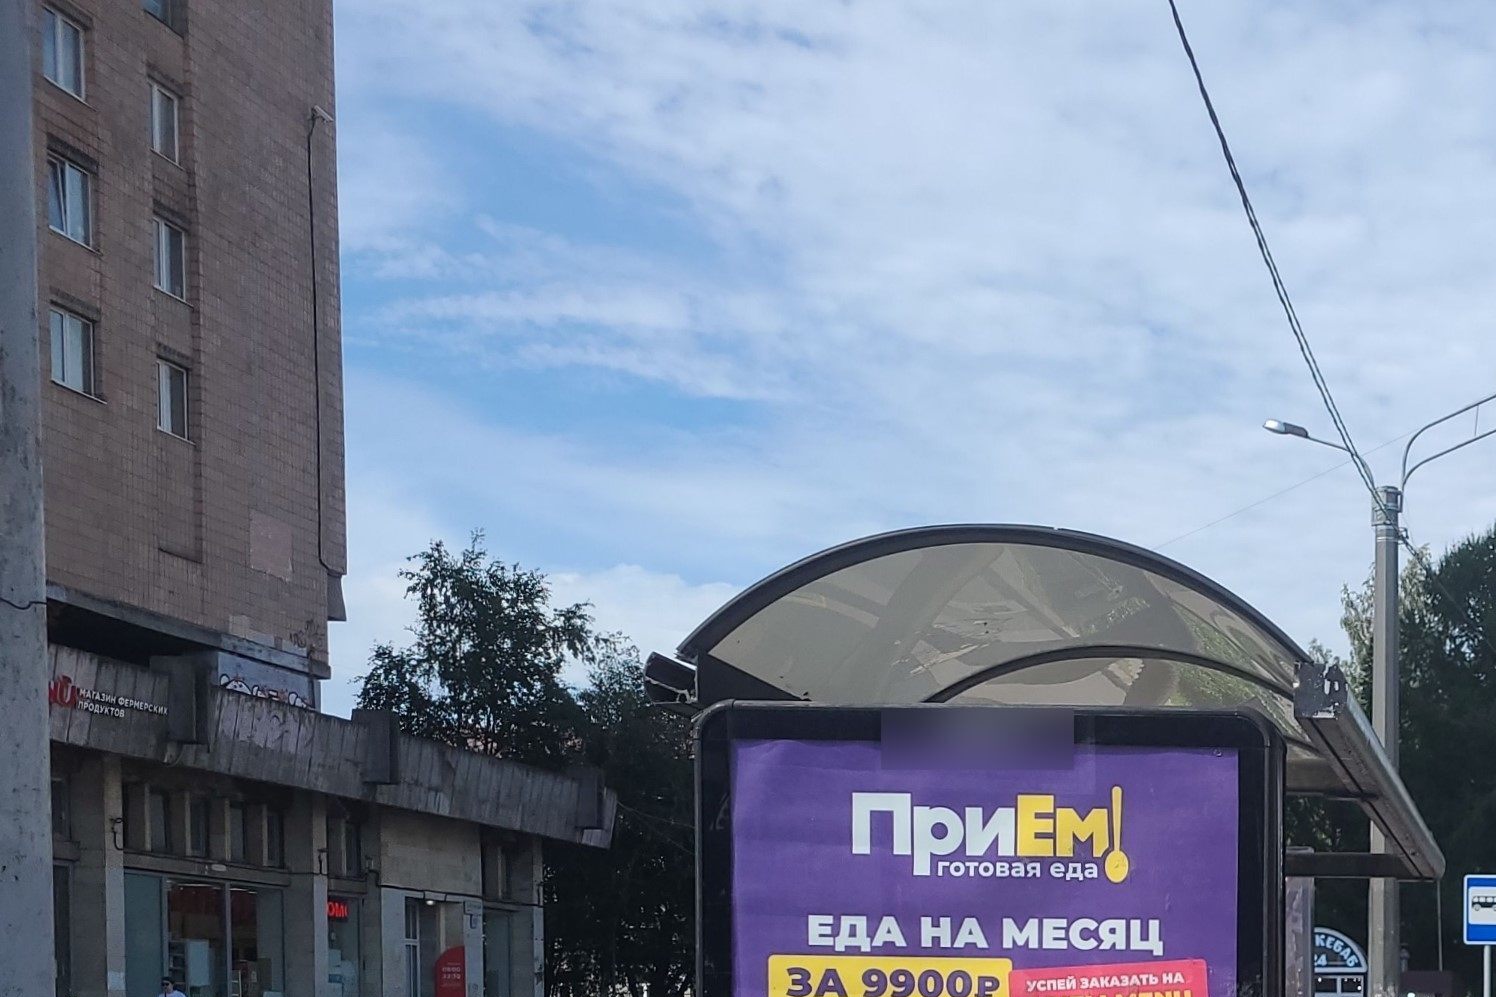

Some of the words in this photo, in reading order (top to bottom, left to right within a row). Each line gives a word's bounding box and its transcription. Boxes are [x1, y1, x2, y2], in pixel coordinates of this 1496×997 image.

[77, 701, 125, 718] ПРОДУКТОВ
[79, 688, 116, 704] МАГАЗИН
[118, 697, 168, 716] ФЕРМЕРСКИХ
[937, 861, 1041, 879] готовая
[1050, 863, 1099, 881] еда
[807, 914, 908, 952] ЕДА
[920, 916, 989, 949] НА
[1002, 918, 1164, 956] МЕСЯЦ
[1315, 934, 1359, 967] КЕБАБ
[787, 967, 848, 997] ЗА
[1027, 976, 1076, 992] УСПЕЙ
[1080, 973, 1158, 989] ЗАКАЗАТЬ
[1162, 972, 1185, 985] НА
